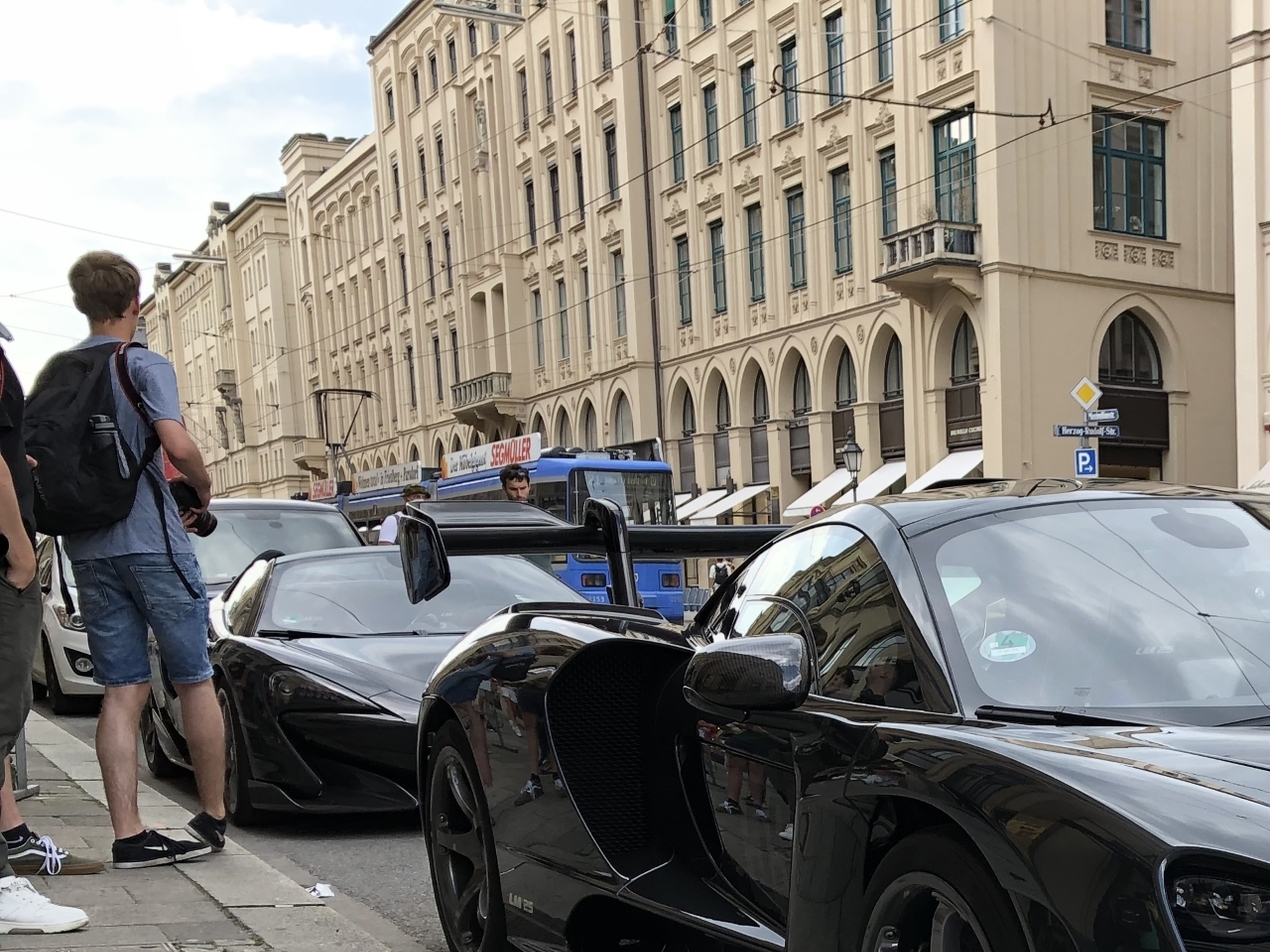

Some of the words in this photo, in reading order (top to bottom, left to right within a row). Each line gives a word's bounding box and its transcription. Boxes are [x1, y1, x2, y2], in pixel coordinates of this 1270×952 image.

[490, 437, 531, 467] SEGMÜLLER
[1078, 452, 1091, 473] P
[509, 893, 522, 909] LM
[523, 899, 534, 914] 25
